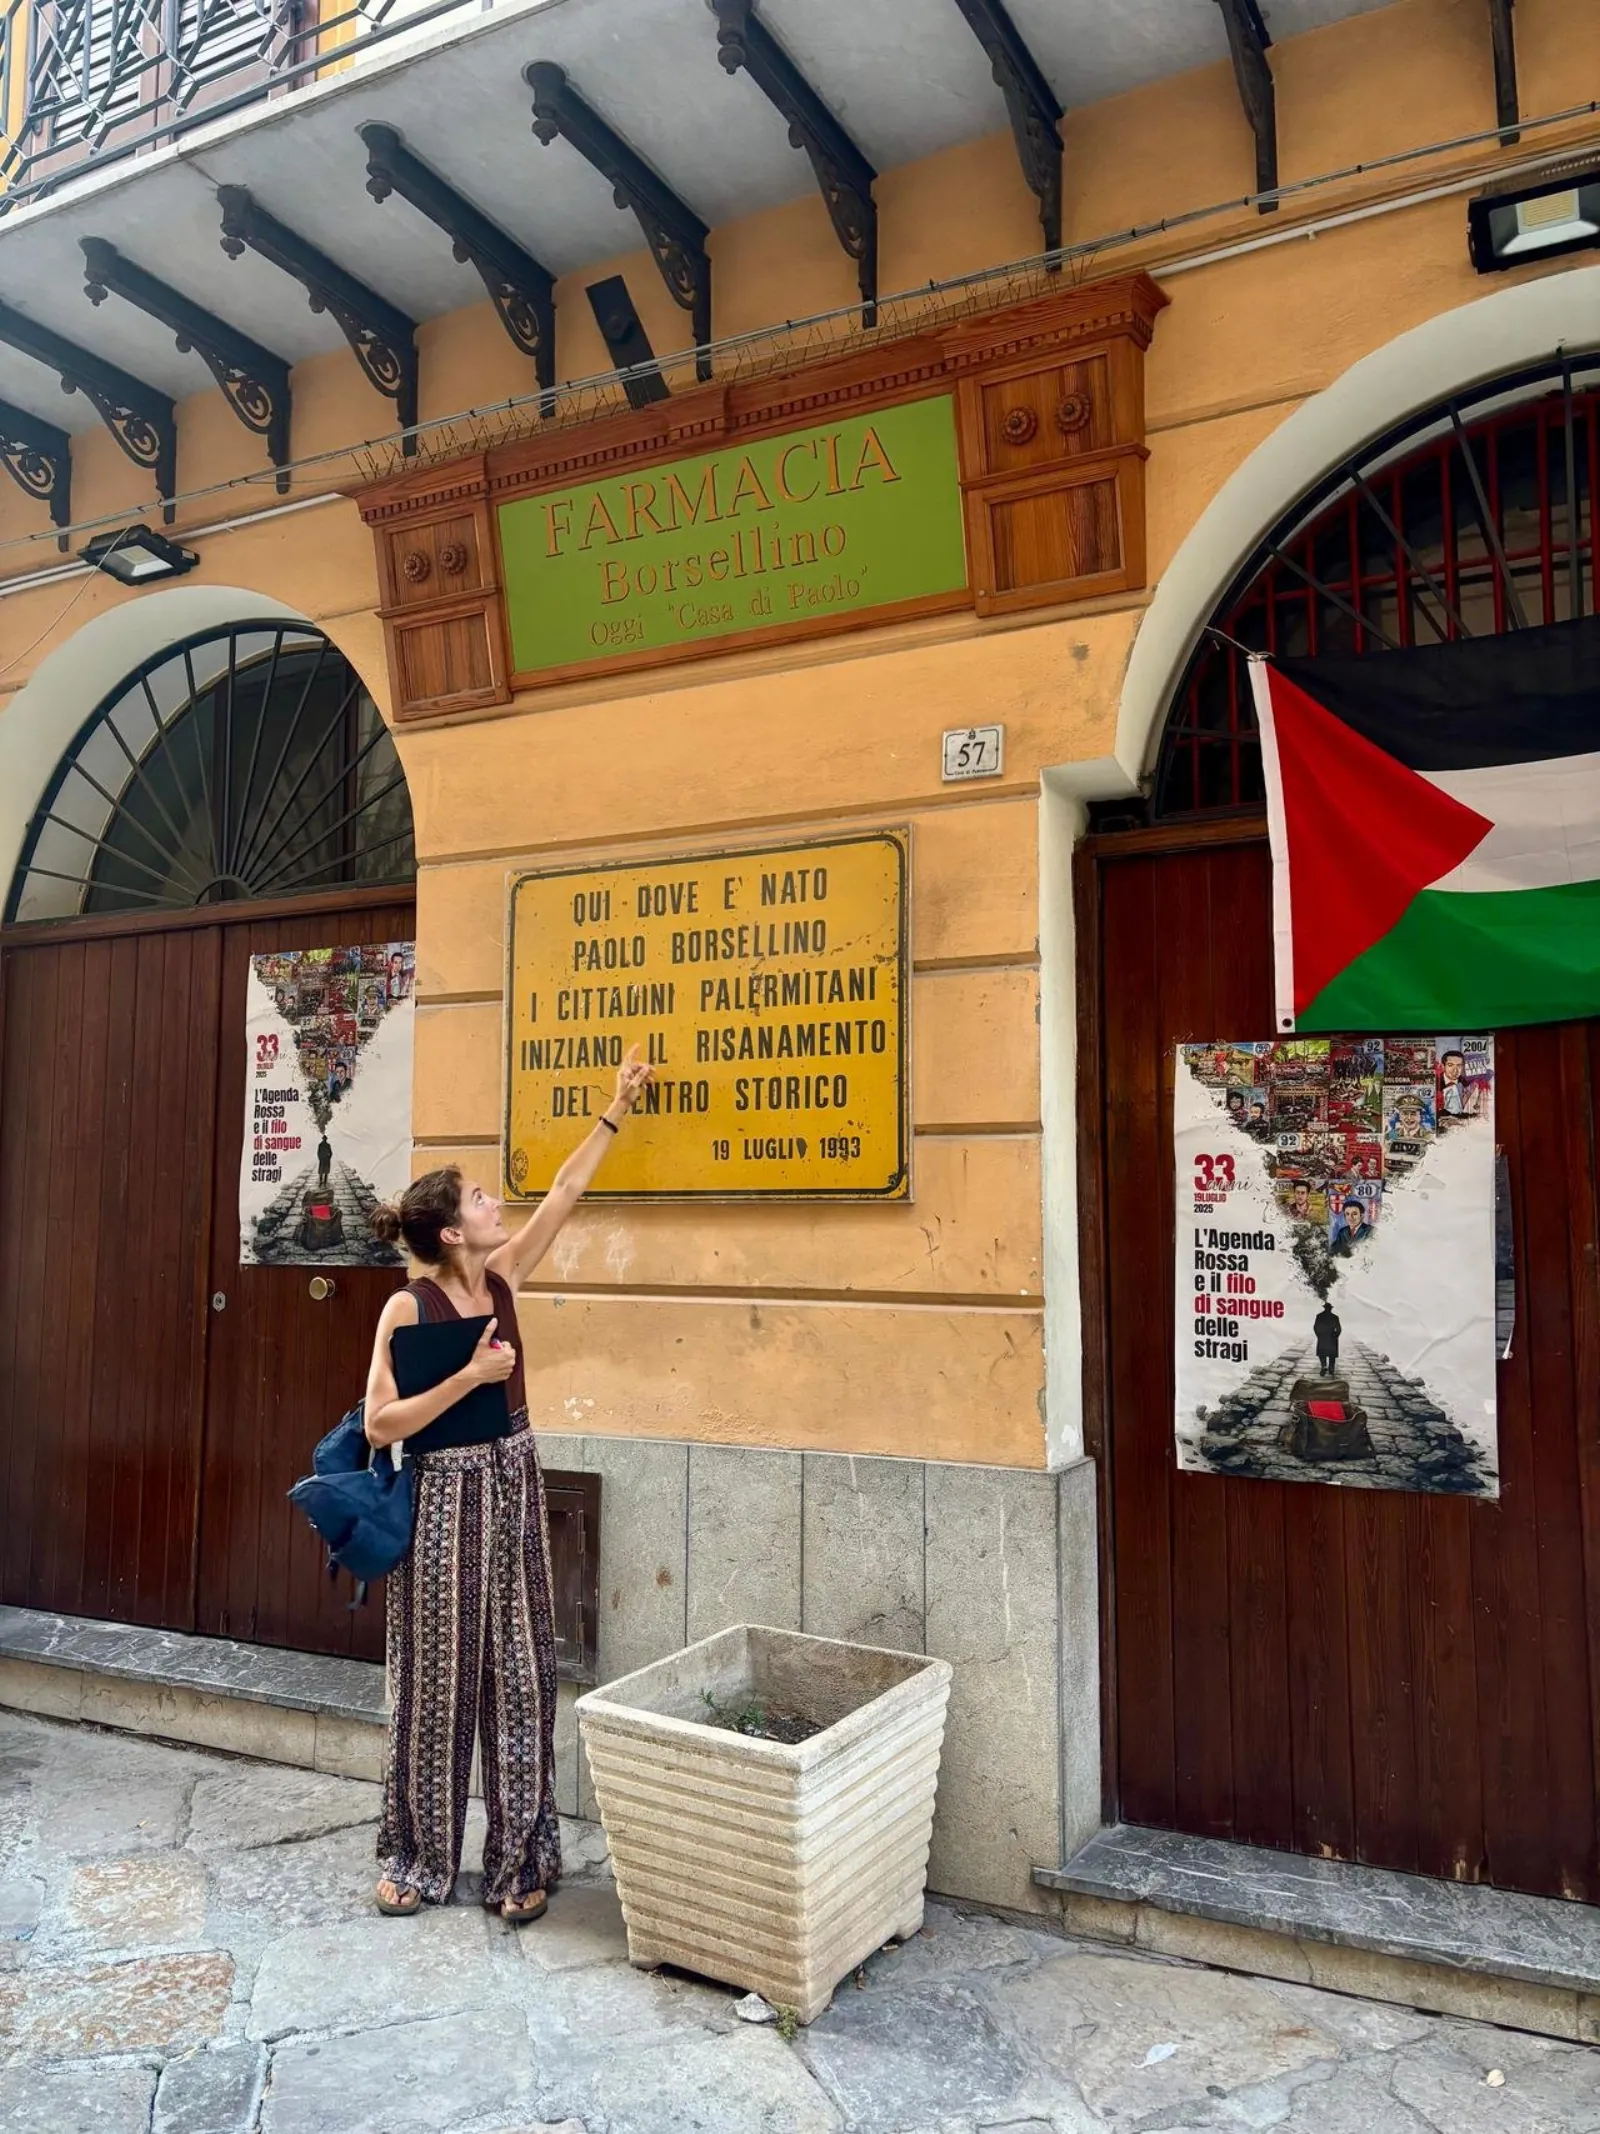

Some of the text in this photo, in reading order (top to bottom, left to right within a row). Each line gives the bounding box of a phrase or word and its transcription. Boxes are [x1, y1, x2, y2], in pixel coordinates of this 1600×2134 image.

[540, 426, 902, 558] FARMACIA
[598, 520, 847, 604] Borsellino
[589, 614, 644, 647] Oggi
[750, 587, 772, 616] di
[957, 741, 986, 768] 57
[573, 889, 611, 926] QUI
[637, 881, 699, 918] DOVE
[761, 867, 828, 906] NATO
[574, 919, 826, 972] PAOLO BORSELLINO
[531, 966, 876, 1023] I CITTADINI PALERMITANI
[257, 1034, 279, 1062] 33
[521, 1020, 886, 1071] INIZIANO IL RISANAMENTO
[1366, 1041, 1380, 1051] 92
[254, 1088, 299, 1104] L'Agenda
[552, 1074, 848, 1118] DEL ENTRO STORICO
[254, 1105, 285, 1119] Rossa
[254, 1119, 287, 1134] e il filo
[254, 1135, 301, 1151] di sangue
[712, 1139, 730, 1161] 19
[820, 1136, 861, 1161] 1993
[253, 1151, 277, 1166] delle
[252, 1167, 282, 1183] stragi
[1194, 1154, 1235, 1191] 33
[1358, 1186, 1372, 1196] 80
[1194, 1204, 1214, 1214] 2025
[1194, 1228, 1275, 1251] L'Agenda
[1194, 1250, 1249, 1272] Rossa
[1194, 1272, 1256, 1294] e il filo
[1194, 1294, 1285, 1319] di sangue
[1194, 1316, 1239, 1338] delle
[1194, 1339, 1248, 1362] stragi
